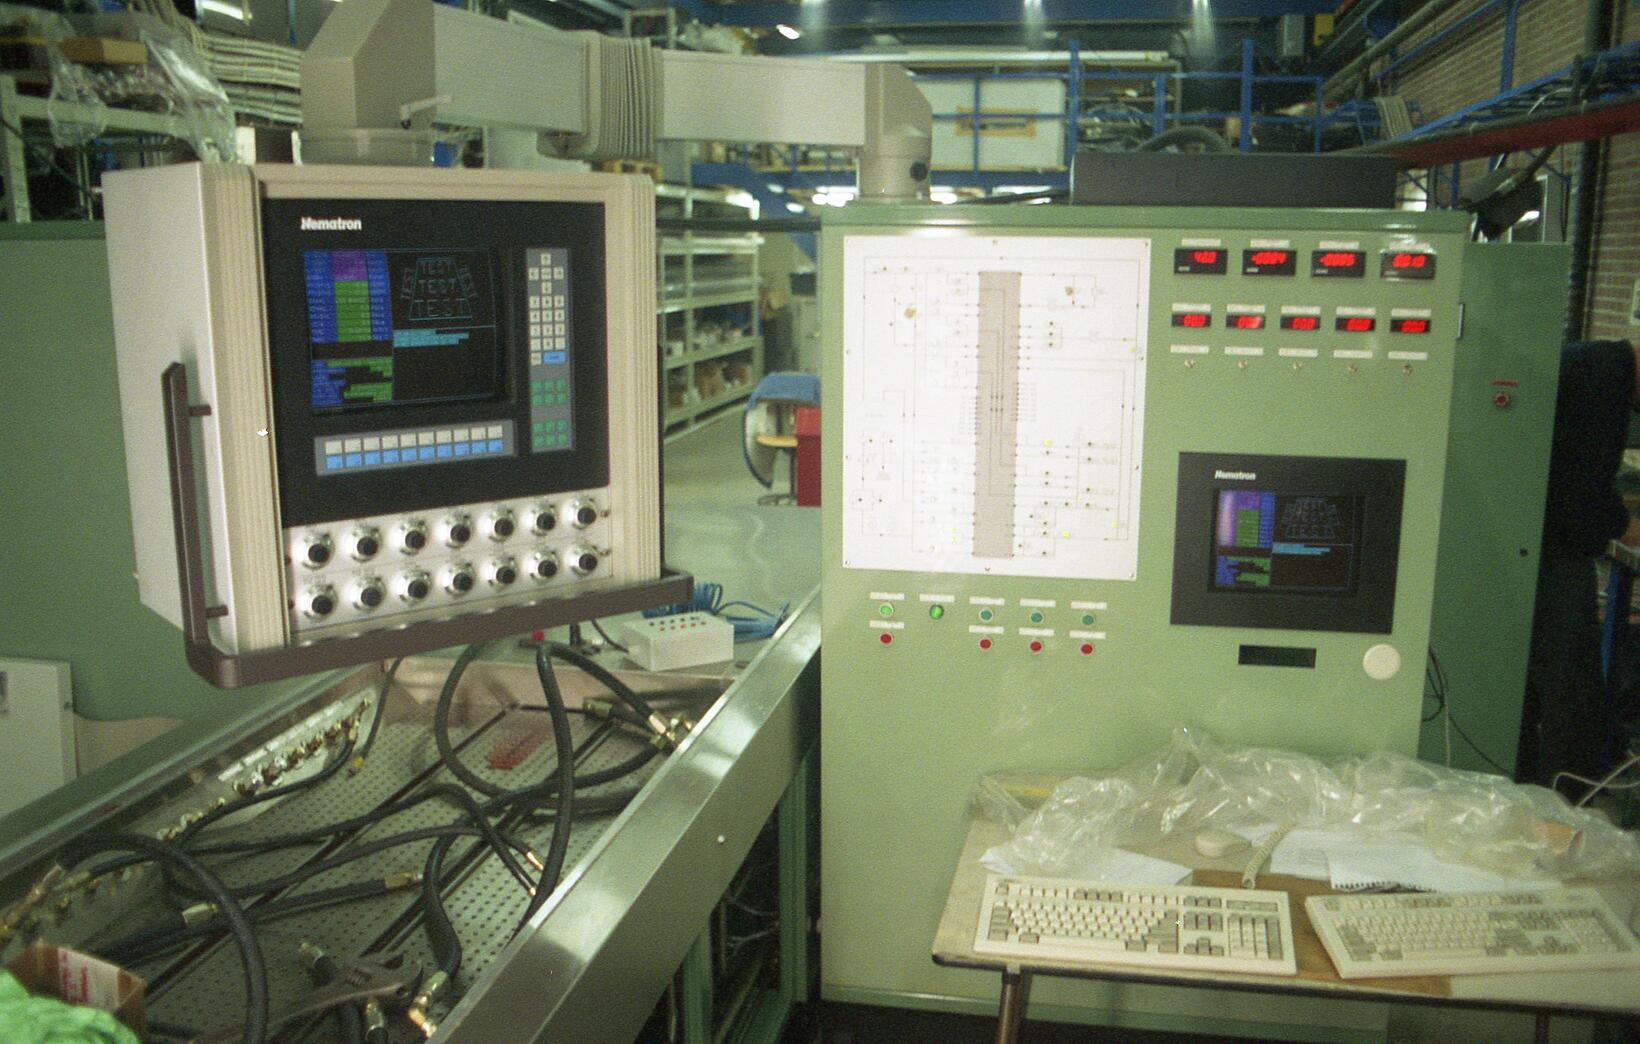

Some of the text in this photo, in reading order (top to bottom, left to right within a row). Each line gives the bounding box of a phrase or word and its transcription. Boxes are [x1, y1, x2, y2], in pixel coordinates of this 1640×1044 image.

[301, 217, 362, 230] Nematron
[418, 278, 456, 294] TEST
[414, 298, 466, 317] TEST
[1214, 470, 1256, 480] Nematron
